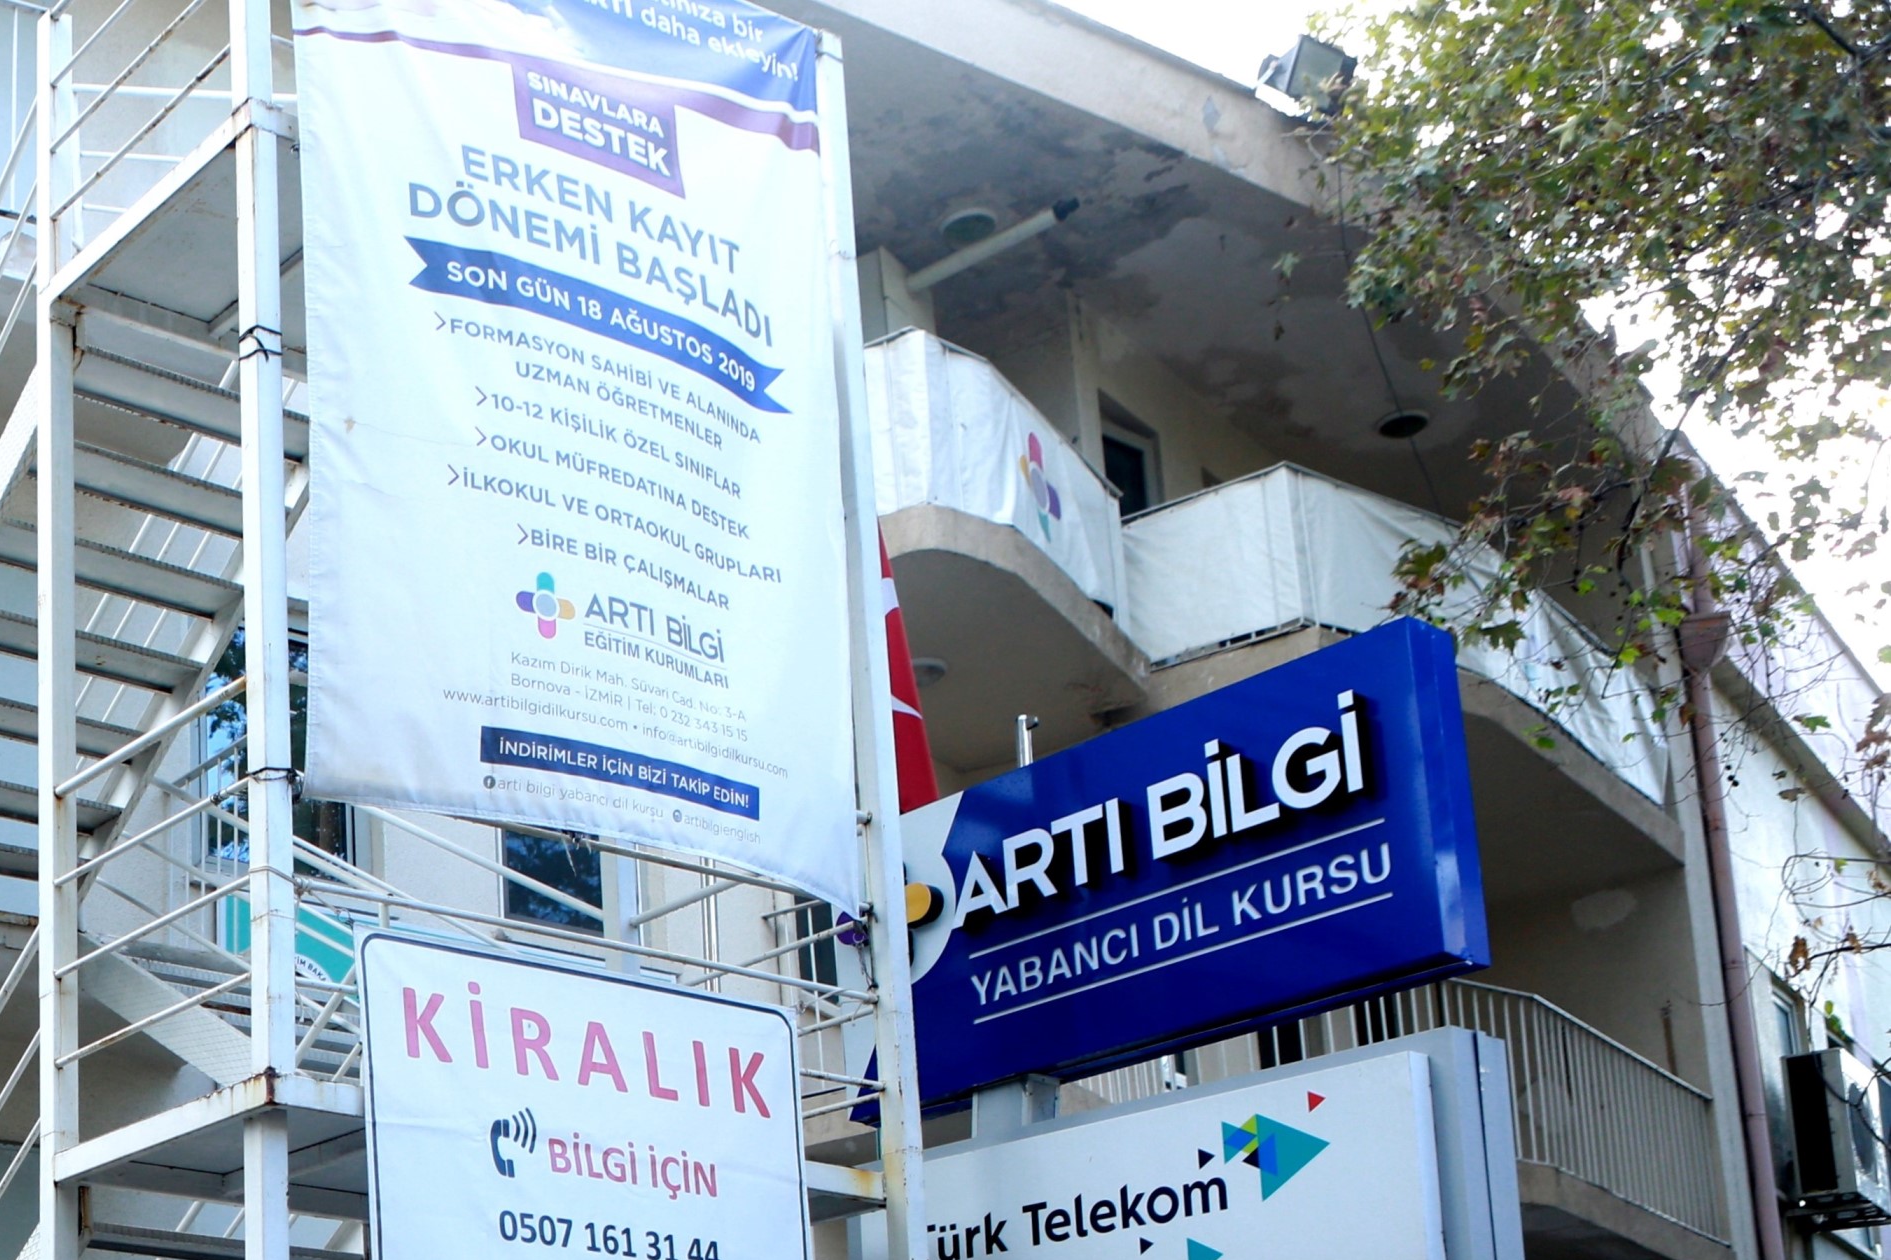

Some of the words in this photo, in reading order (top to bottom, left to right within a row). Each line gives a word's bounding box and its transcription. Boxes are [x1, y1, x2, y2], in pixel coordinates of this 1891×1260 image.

[640, 7, 701, 46] daha
[707, 35, 799, 82] ekleyin!
[732, 14, 764, 42] bir
[527, 70, 665, 139] SINAVLARA
[532, 100, 671, 177] DESTEK
[461, 143, 614, 224] ERKEN
[628, 198, 741, 276] KAYIT
[409, 180, 602, 267] DÖNEMİ
[616, 240, 773, 348] BAŞLADI
[447, 260, 508, 292] SON
[516, 272, 572, 312] GÜN
[576, 294, 603, 321] 18
[610, 306, 713, 366] AĞUSTOS
[717, 351, 757, 394] 2019
[450, 318, 586, 366] FORMASYON
[591, 353, 653, 390] SAHİBİ
[657, 378, 682, 400] VE
[685, 390, 761, 444] ALANINDA
[515, 360, 591, 396] UZMAN
[596, 381, 723, 451] ÖĞRETMENLER
[491, 393, 544, 419] 10-12
[550, 407, 618, 443] KİŞİLİK
[623, 428, 670, 463] ÖZEL
[675, 451, 742, 500] SINIFLAR
[462, 465, 557, 507] İLKOKUL
[561, 493, 589, 516] VE
[594, 504, 691, 554] ORTAOKUL
[694, 542, 782, 584] GRUPLARI
[490, 434, 550, 464] OKUL
[555, 449, 687, 511] MÜFREDATINA
[691, 498, 750, 541] DESTEK
[531, 527, 578, 556] BİRE
[584, 541, 617, 567] BİR
[623, 555, 729, 611] ÇALIŞMALAR
[584, 593, 655, 636] ARTI
[666, 613, 726, 663] BİLGİ
[584, 631, 641, 660] EĞİTİM
[644, 643, 729, 690] KURUMLARI
[510, 651, 556, 673] Kazım
[560, 659, 592, 680] Dirik
[595, 669, 628, 688] Mah.
[443, 689, 628, 733] www.artibilgidilkursu.com
[510, 674, 571, 697] Bornova
[584, 686, 624, 708] İZMİR
[660, 705, 668, 719] 0
[669, 709, 691, 729] 232
[693, 717, 719, 735] 343
[721, 724, 734, 739] 15
[736, 727, 749, 743] 15
[499, 736, 598, 770] İNDİRİMLER
[602, 756, 634, 777] İÇİN
[638, 764, 667, 785] BİZİ
[670, 772, 711, 796] TAKİP
[713, 785, 750, 809] EDİN!
[953, 797, 1125, 930] ARTI
[1146, 688, 1364, 861] BİLGİ
[969, 921, 1140, 1007] YABANCI
[1153, 896, 1220, 951] DİL
[1232, 842, 1392, 927] KURSU
[402, 980, 772, 1120] KİRALIK
[547, 1132, 639, 1186] BİLGİ
[647, 1144, 719, 1201] İÇİN
[498, 1210, 574, 1248] 0507
[585, 1221, 637, 1259] 161
[1022, 1174, 1229, 1249] Telekom
